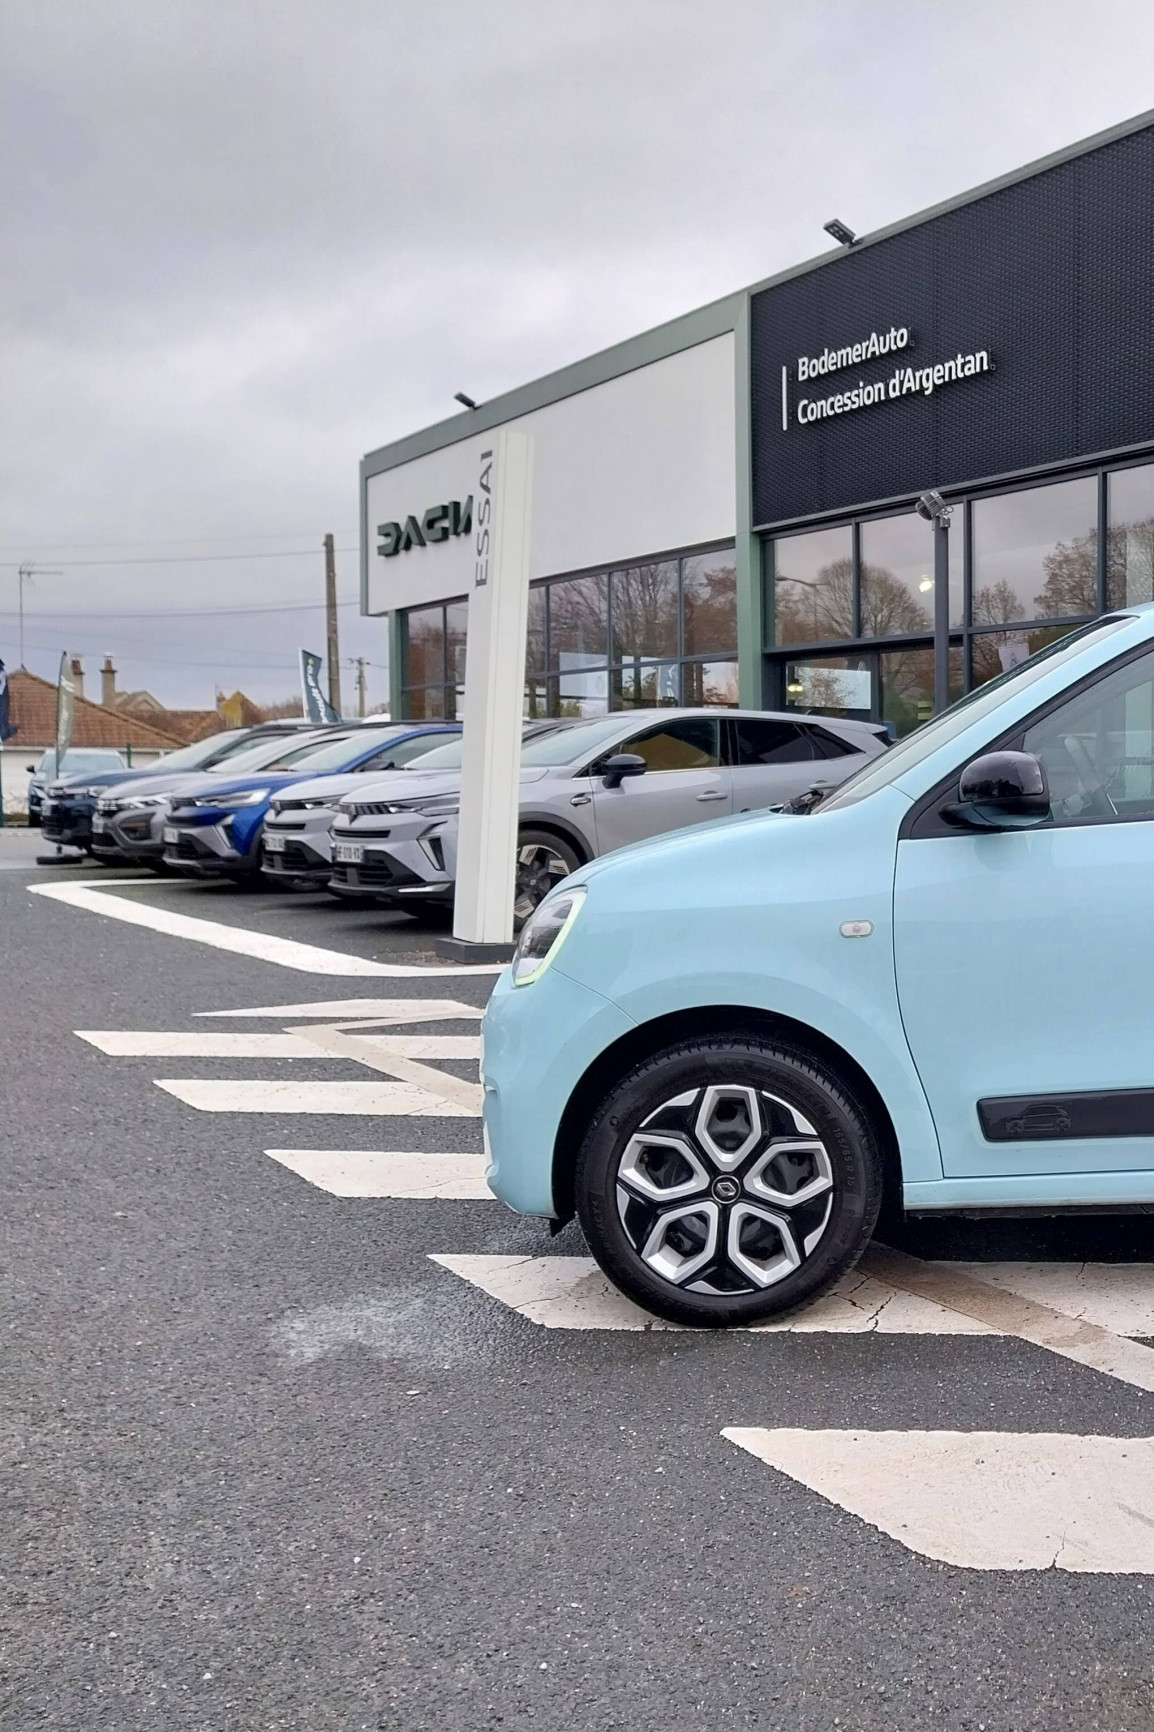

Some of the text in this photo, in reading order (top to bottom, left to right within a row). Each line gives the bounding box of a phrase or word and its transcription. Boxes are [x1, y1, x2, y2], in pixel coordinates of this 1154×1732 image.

[798, 327, 908, 382] BodemerAuto
[798, 350, 989, 424] Concession d'Argentan
[475, 449, 493, 590] ESSAI
